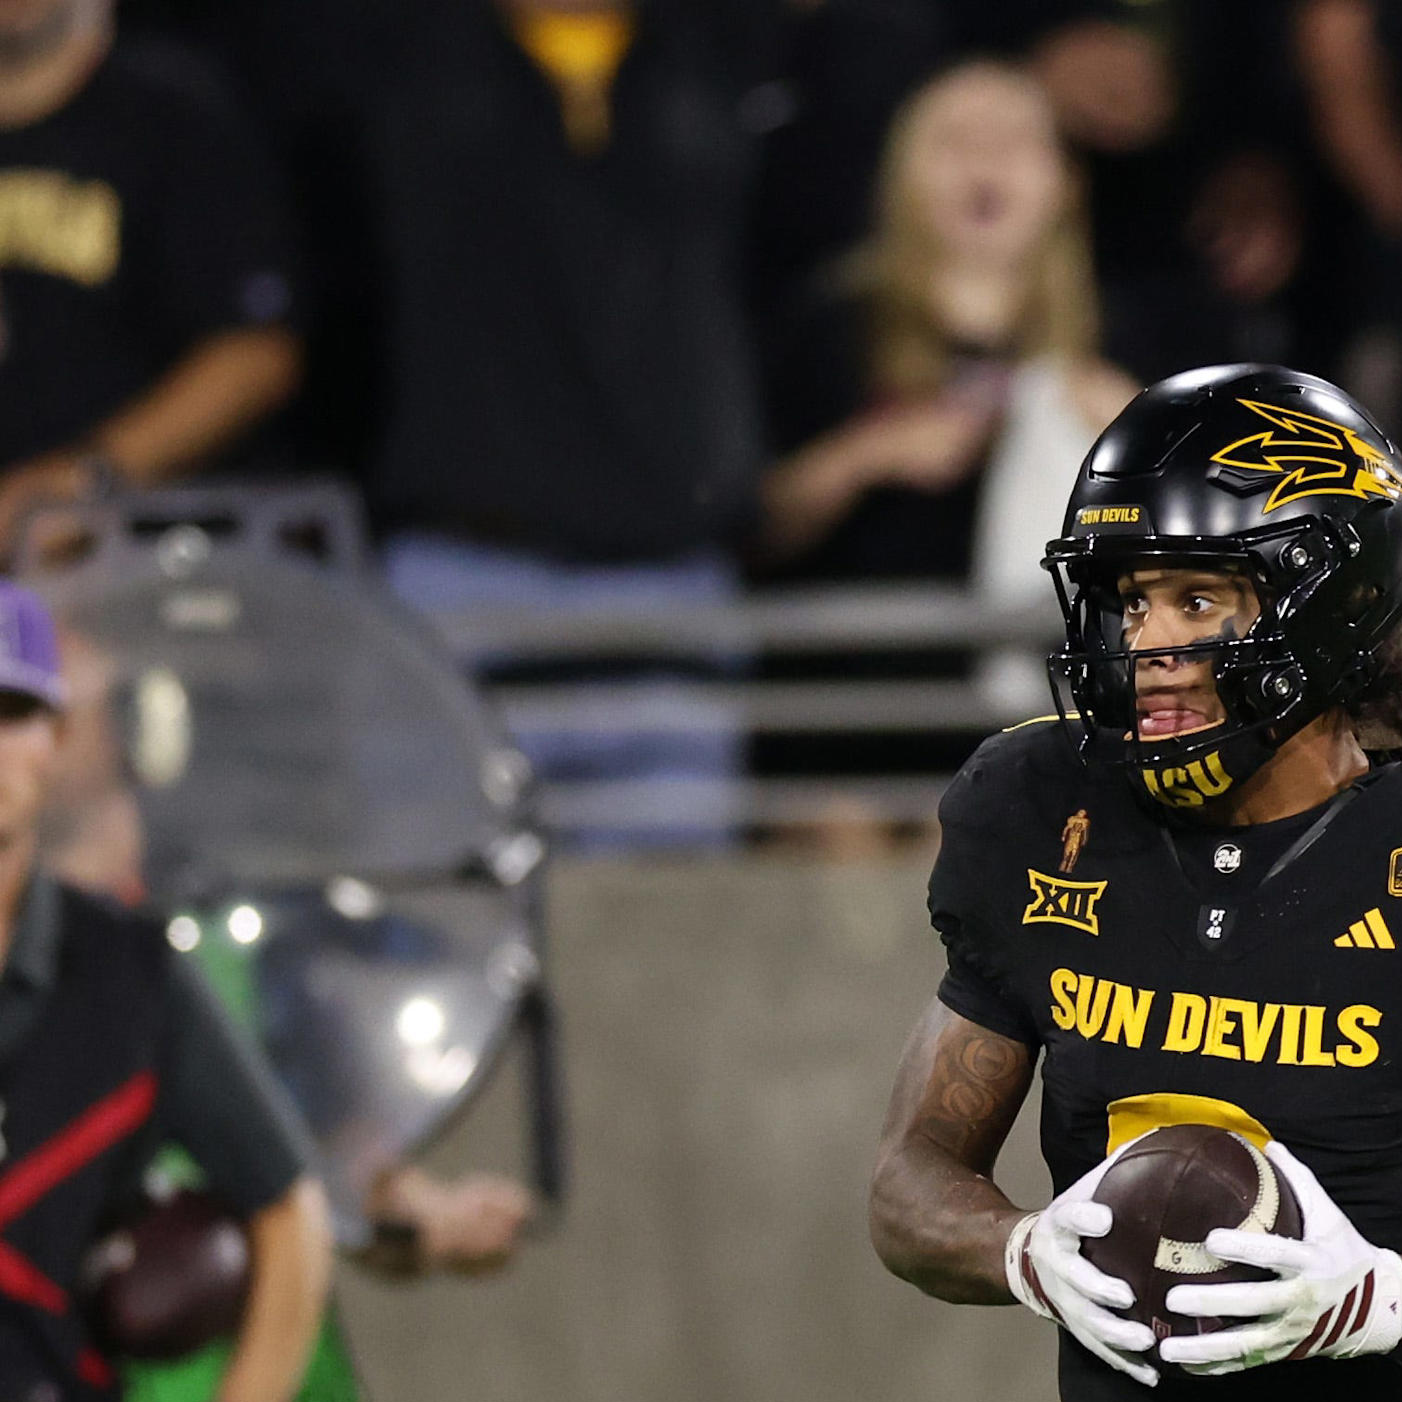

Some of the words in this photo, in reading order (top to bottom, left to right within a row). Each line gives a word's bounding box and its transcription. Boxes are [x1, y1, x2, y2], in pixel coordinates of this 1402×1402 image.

[1081, 509, 1101, 525] SUN
[1101, 507, 1140, 523] DEVILS
[1024, 871, 1105, 932] XII
[1209, 909, 1226, 922] PT
[1205, 926, 1222, 939] 42
[1050, 968, 1156, 1049] SUN
[1161, 991, 1383, 1068] DEVILS
